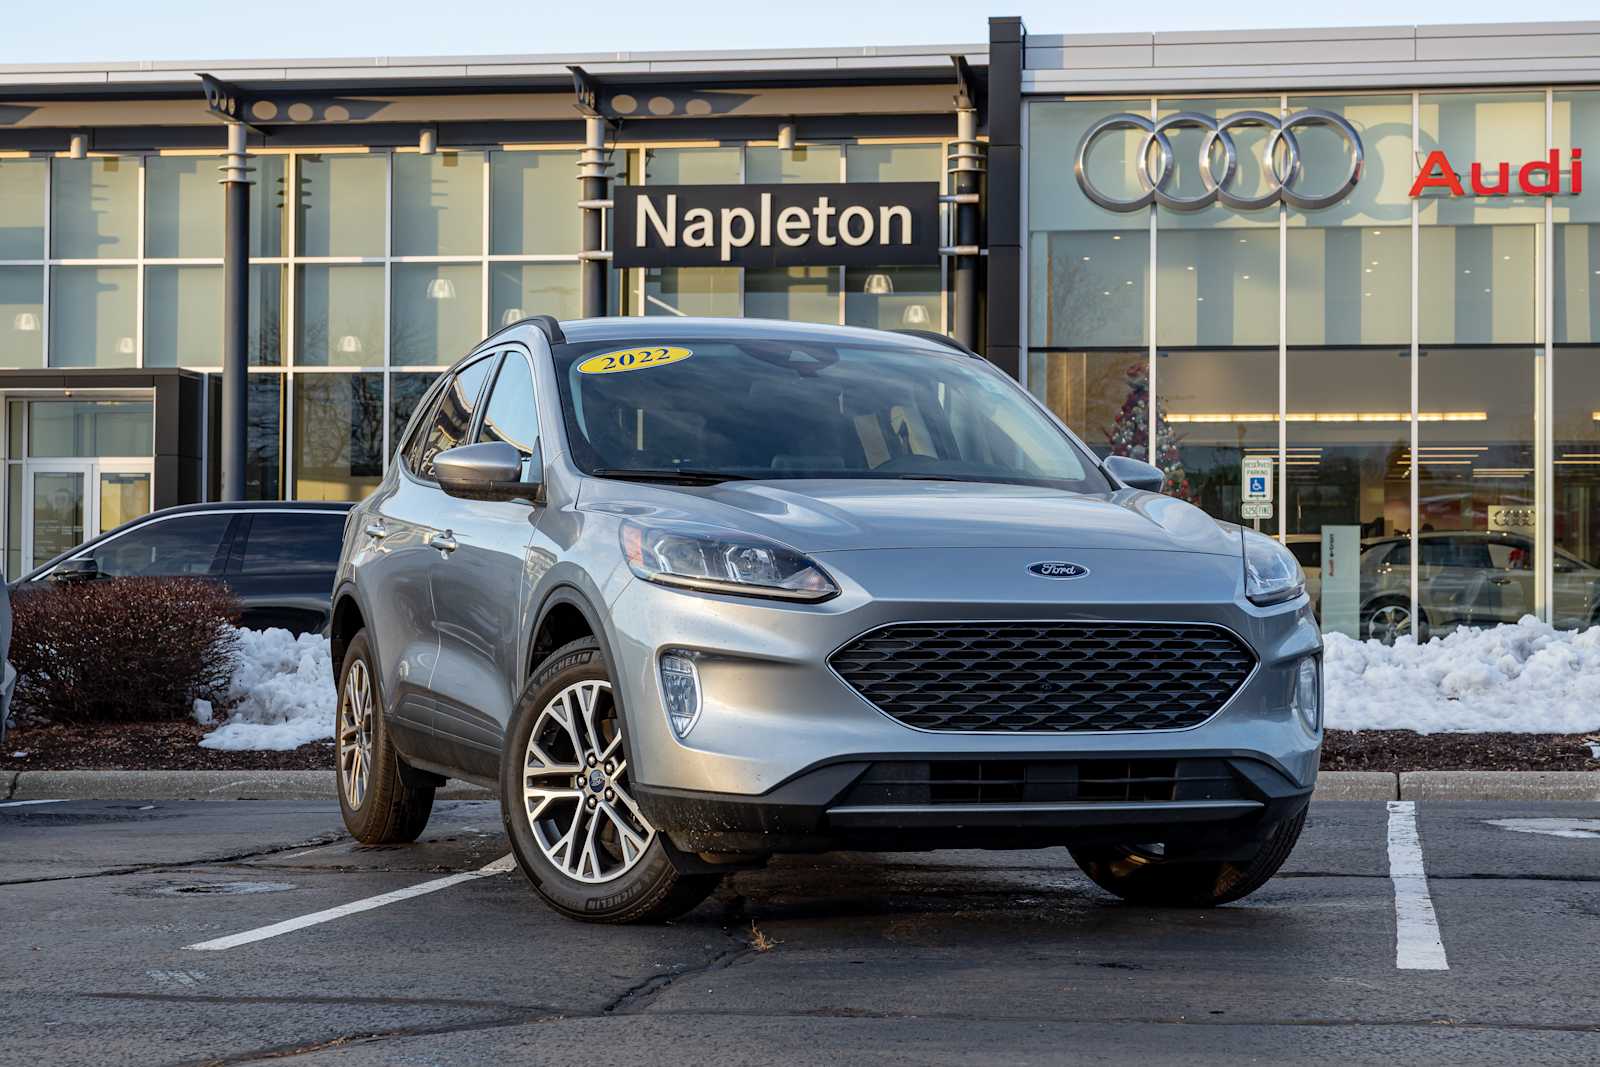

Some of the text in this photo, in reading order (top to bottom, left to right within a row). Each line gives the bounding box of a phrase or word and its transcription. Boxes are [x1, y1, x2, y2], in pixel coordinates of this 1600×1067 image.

[1408, 148, 1582, 197] Audi
[636, 192, 912, 262] Napleton
[601, 347, 670, 370] 2022
[1041, 563, 1076, 575] Ford
[541, 651, 592, 685] MICHELIN
